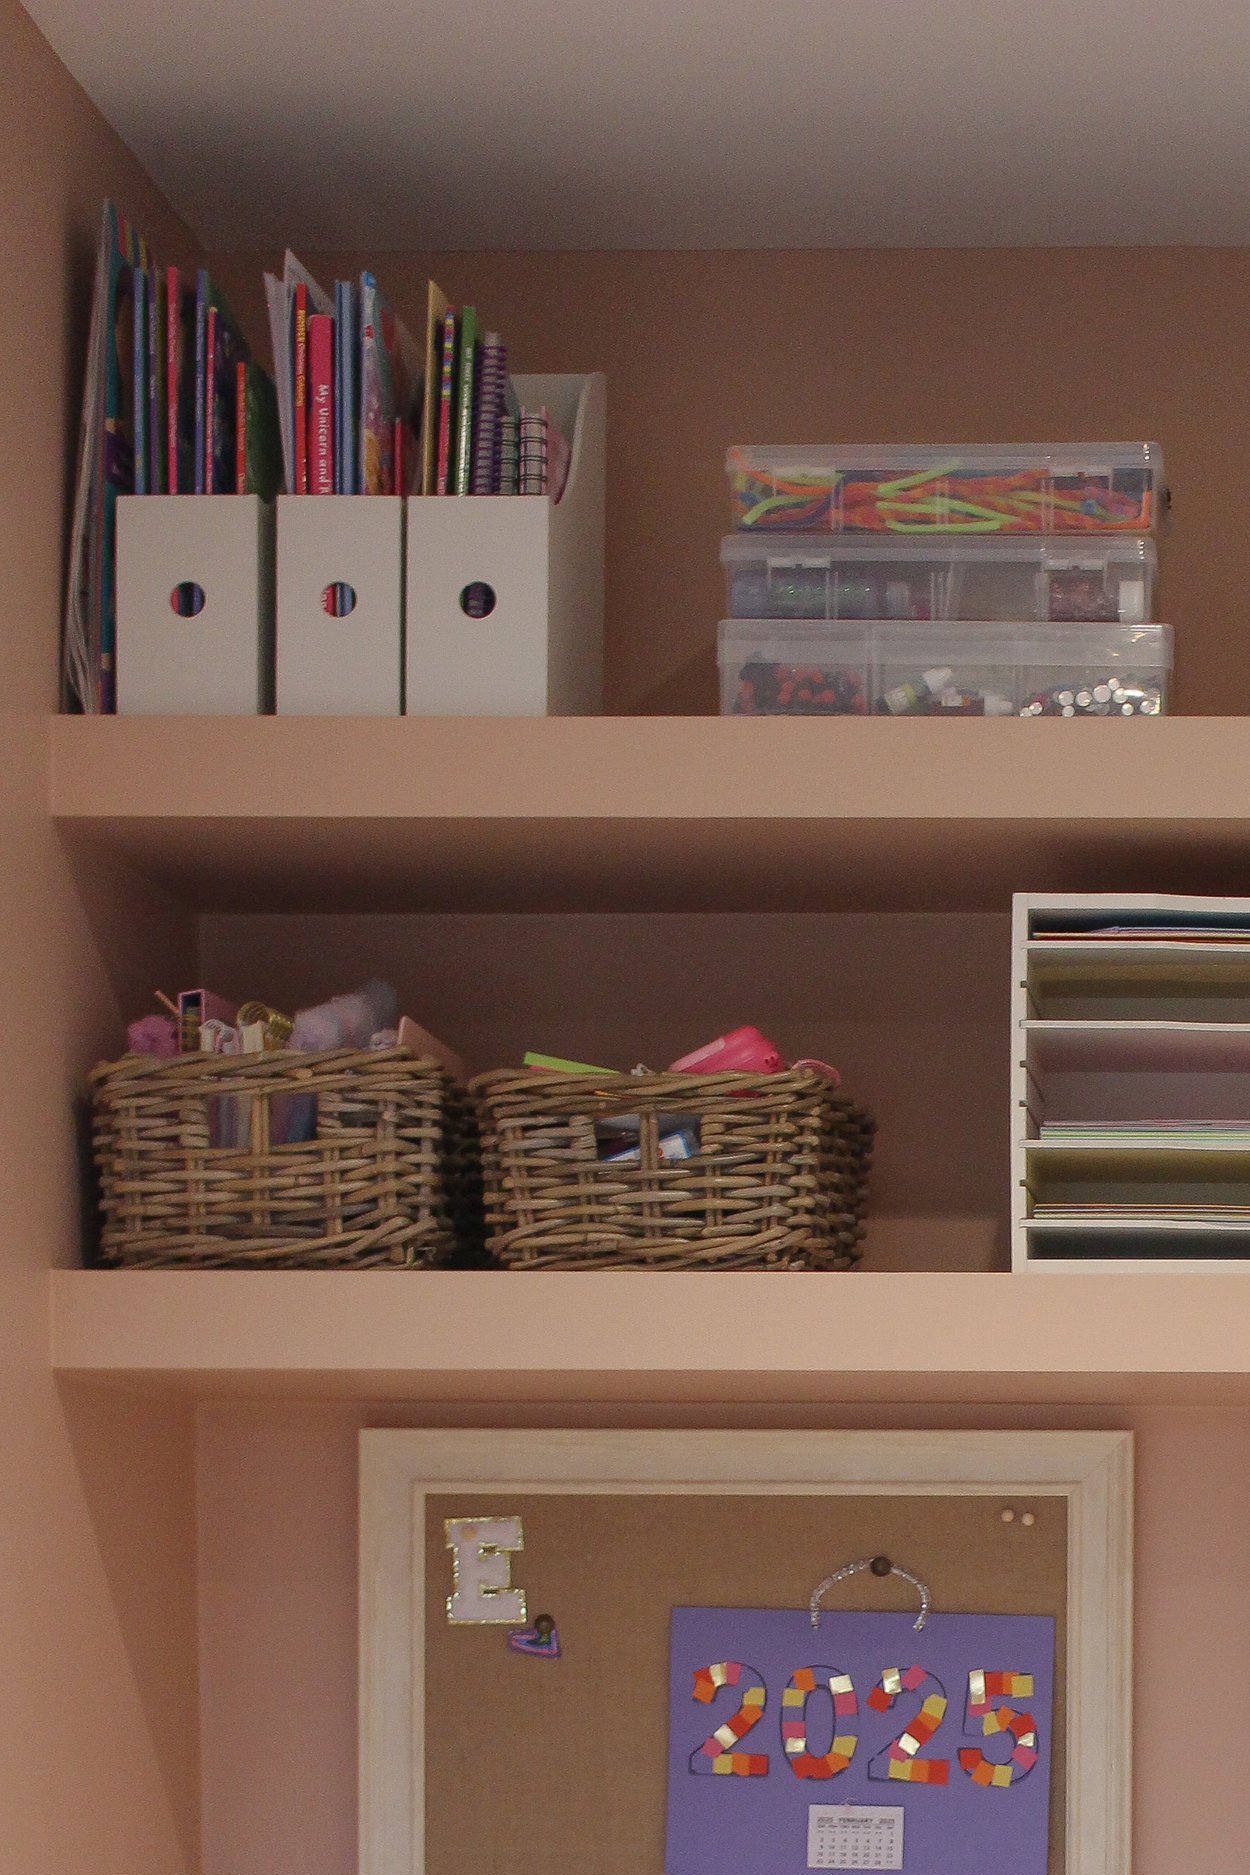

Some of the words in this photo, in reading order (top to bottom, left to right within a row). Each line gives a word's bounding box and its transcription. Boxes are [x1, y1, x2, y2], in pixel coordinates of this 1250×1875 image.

[315, 384, 329, 404] My
[318, 408, 329, 456] Unicorn
[319, 459, 332, 482] and
[444, 1516, 527, 1626] E
[688, 1661, 1040, 1788] 2025
